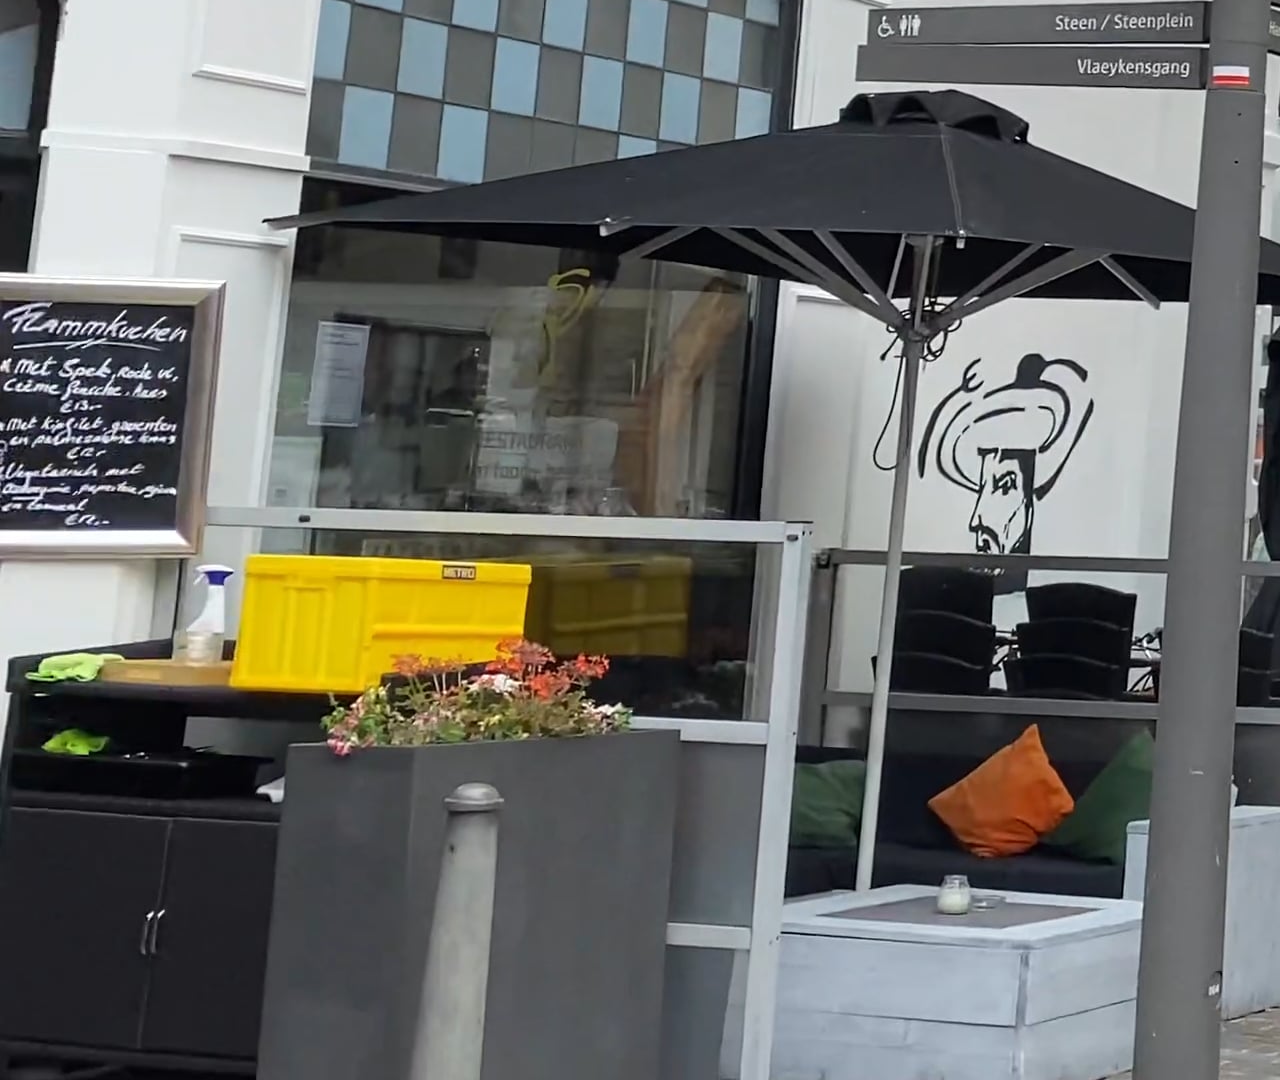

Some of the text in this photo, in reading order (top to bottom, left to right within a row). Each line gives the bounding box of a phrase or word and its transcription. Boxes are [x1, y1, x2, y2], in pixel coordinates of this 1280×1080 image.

[1055, 13, 1193, 33] Steen / Steenplein
[1077, 58, 1190, 78] Vlaeykensgang
